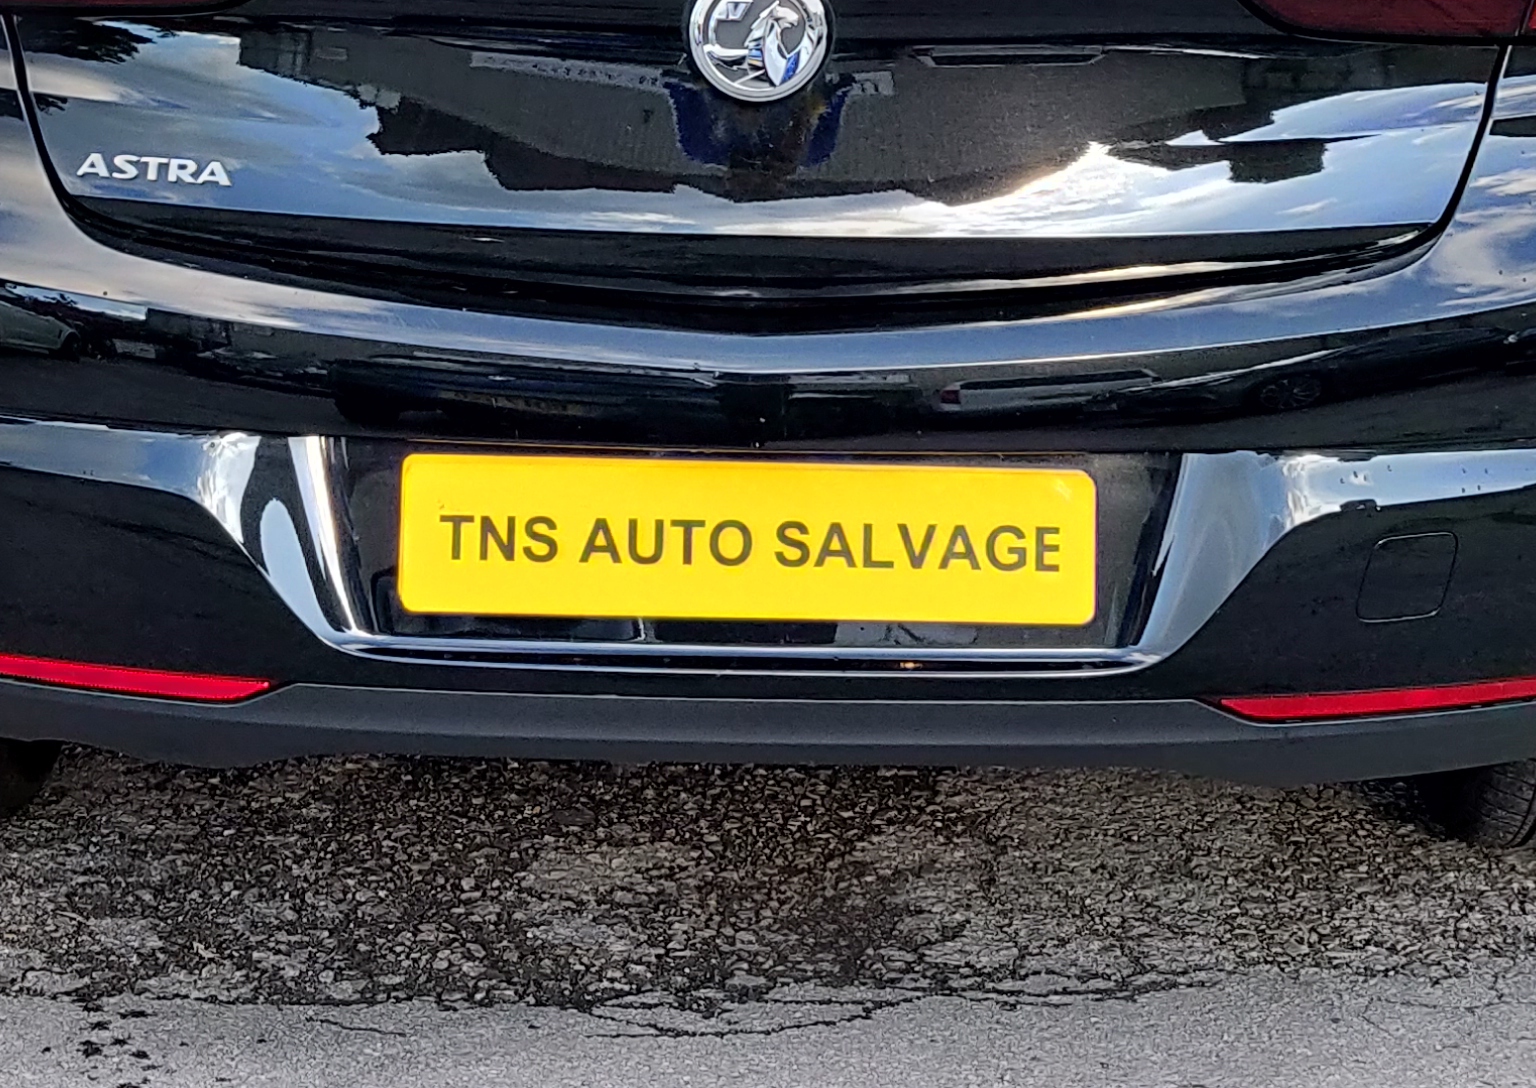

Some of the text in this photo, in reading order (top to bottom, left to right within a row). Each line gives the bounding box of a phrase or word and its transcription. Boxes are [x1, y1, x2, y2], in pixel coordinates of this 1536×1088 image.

[77, 153, 232, 186] ASTRA
[440, 515, 1060, 572] TNS AUTO SALVAGE
